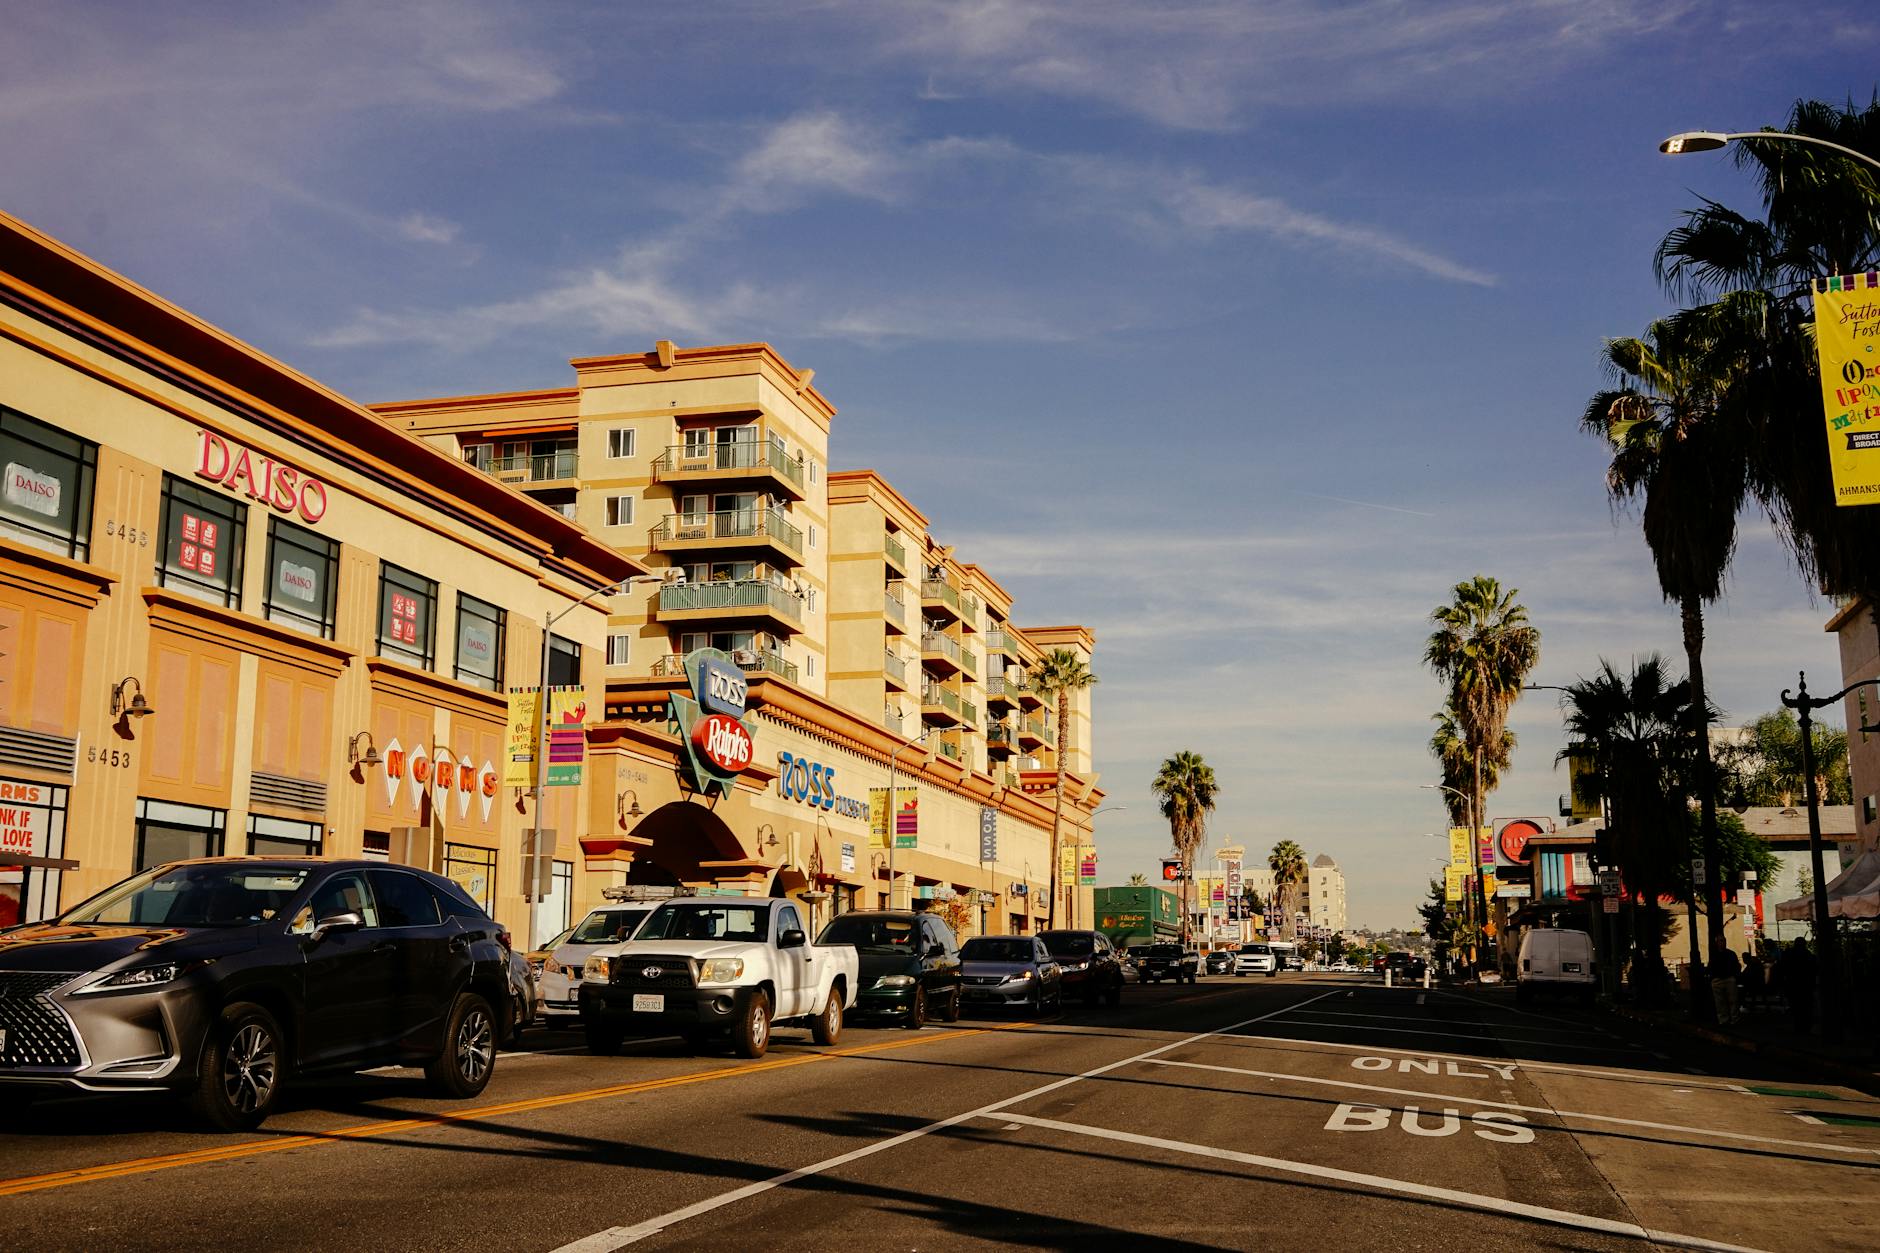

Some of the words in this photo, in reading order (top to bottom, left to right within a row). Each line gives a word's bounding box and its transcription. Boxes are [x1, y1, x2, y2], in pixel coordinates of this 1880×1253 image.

[1839, 301, 1880, 325] Sutto
[1852, 432, 1880, 441] DIRECT
[15, 474, 55, 498] DAISO
[195, 429, 327, 524] DAISO
[285, 571, 312, 590] DAISO
[467, 638, 487, 652] DAISO
[710, 670, 746, 708] ROSS
[707, 718, 750, 766] Ralphs
[87, 745, 131, 768] 5453
[387, 750, 498, 798] NORMS
[777, 751, 836, 811] ROSS
[1, 783, 40, 802] RMS
[19, 811, 31, 828] IF
[3, 829, 33, 847] LOVE
[983, 809, 992, 859] ROSS
[1351, 1056, 1519, 1080] ONLY
[1323, 1102, 1535, 1144] BUS
